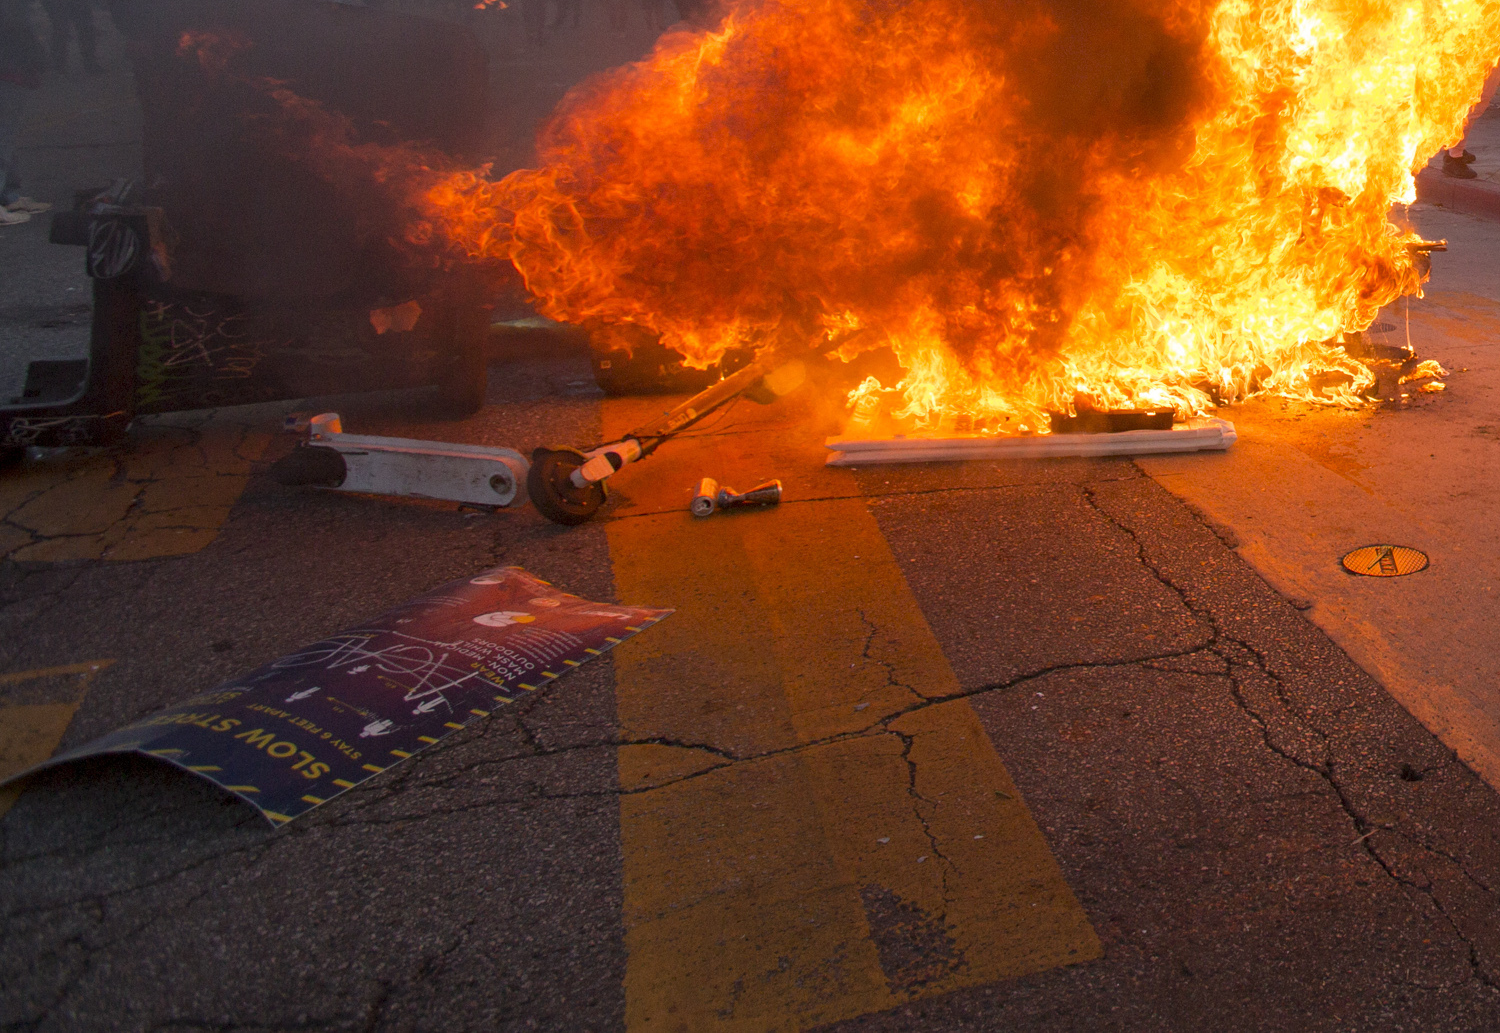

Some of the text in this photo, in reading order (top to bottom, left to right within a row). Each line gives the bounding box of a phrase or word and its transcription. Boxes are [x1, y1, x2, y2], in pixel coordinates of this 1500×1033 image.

[433, 641, 486, 661] MEDICAL
[472, 637, 535, 670] OUTDOORS
[492, 653, 527, 676] MASK
[470, 662, 505, 686] WEAR
[245, 703, 363, 760] STAY 6 FEET APART
[233, 728, 331, 780] SLOW
